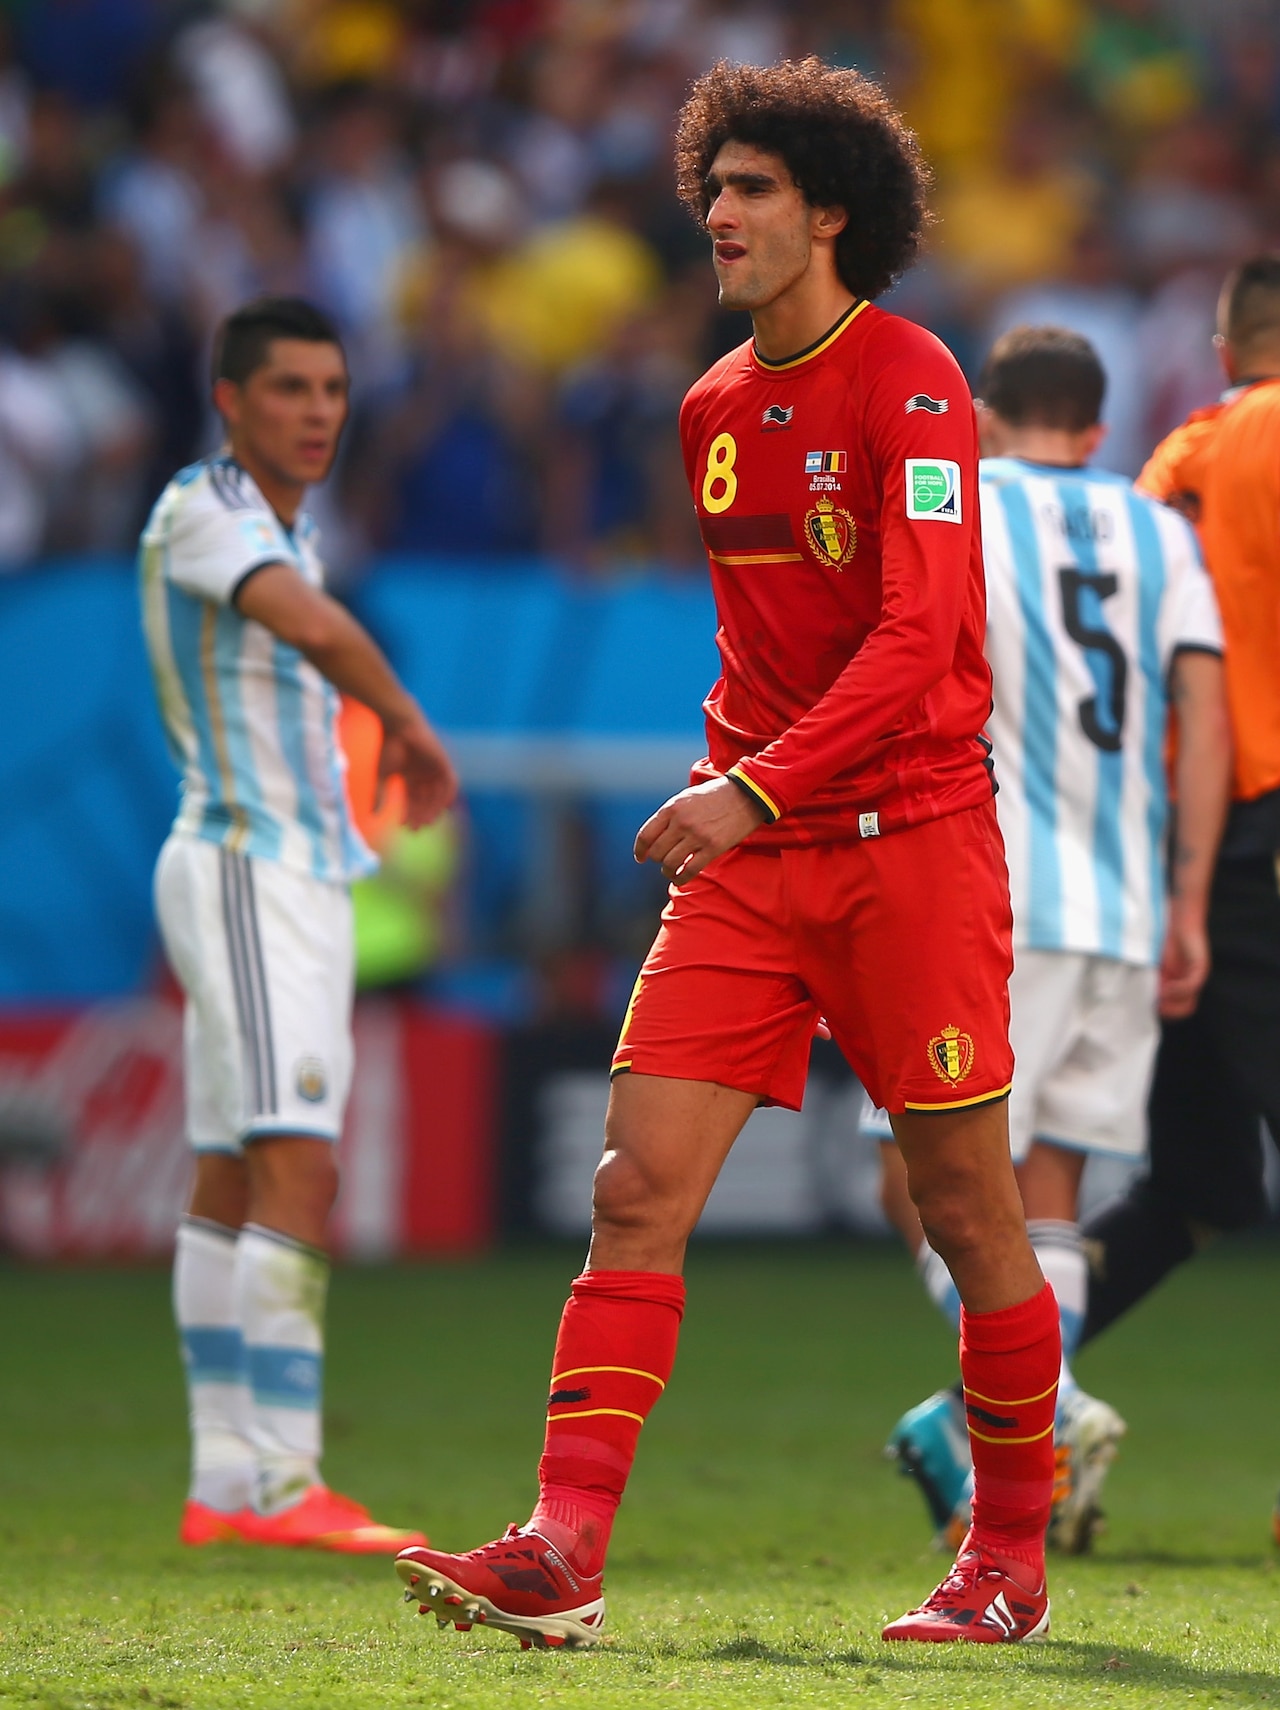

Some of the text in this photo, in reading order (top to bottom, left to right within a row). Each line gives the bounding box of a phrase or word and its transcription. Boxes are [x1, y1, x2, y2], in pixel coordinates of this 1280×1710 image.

[702, 432, 738, 514] 8
[809, 483, 841, 491] 05.07.2014
[1058, 567, 1127, 753] 5
